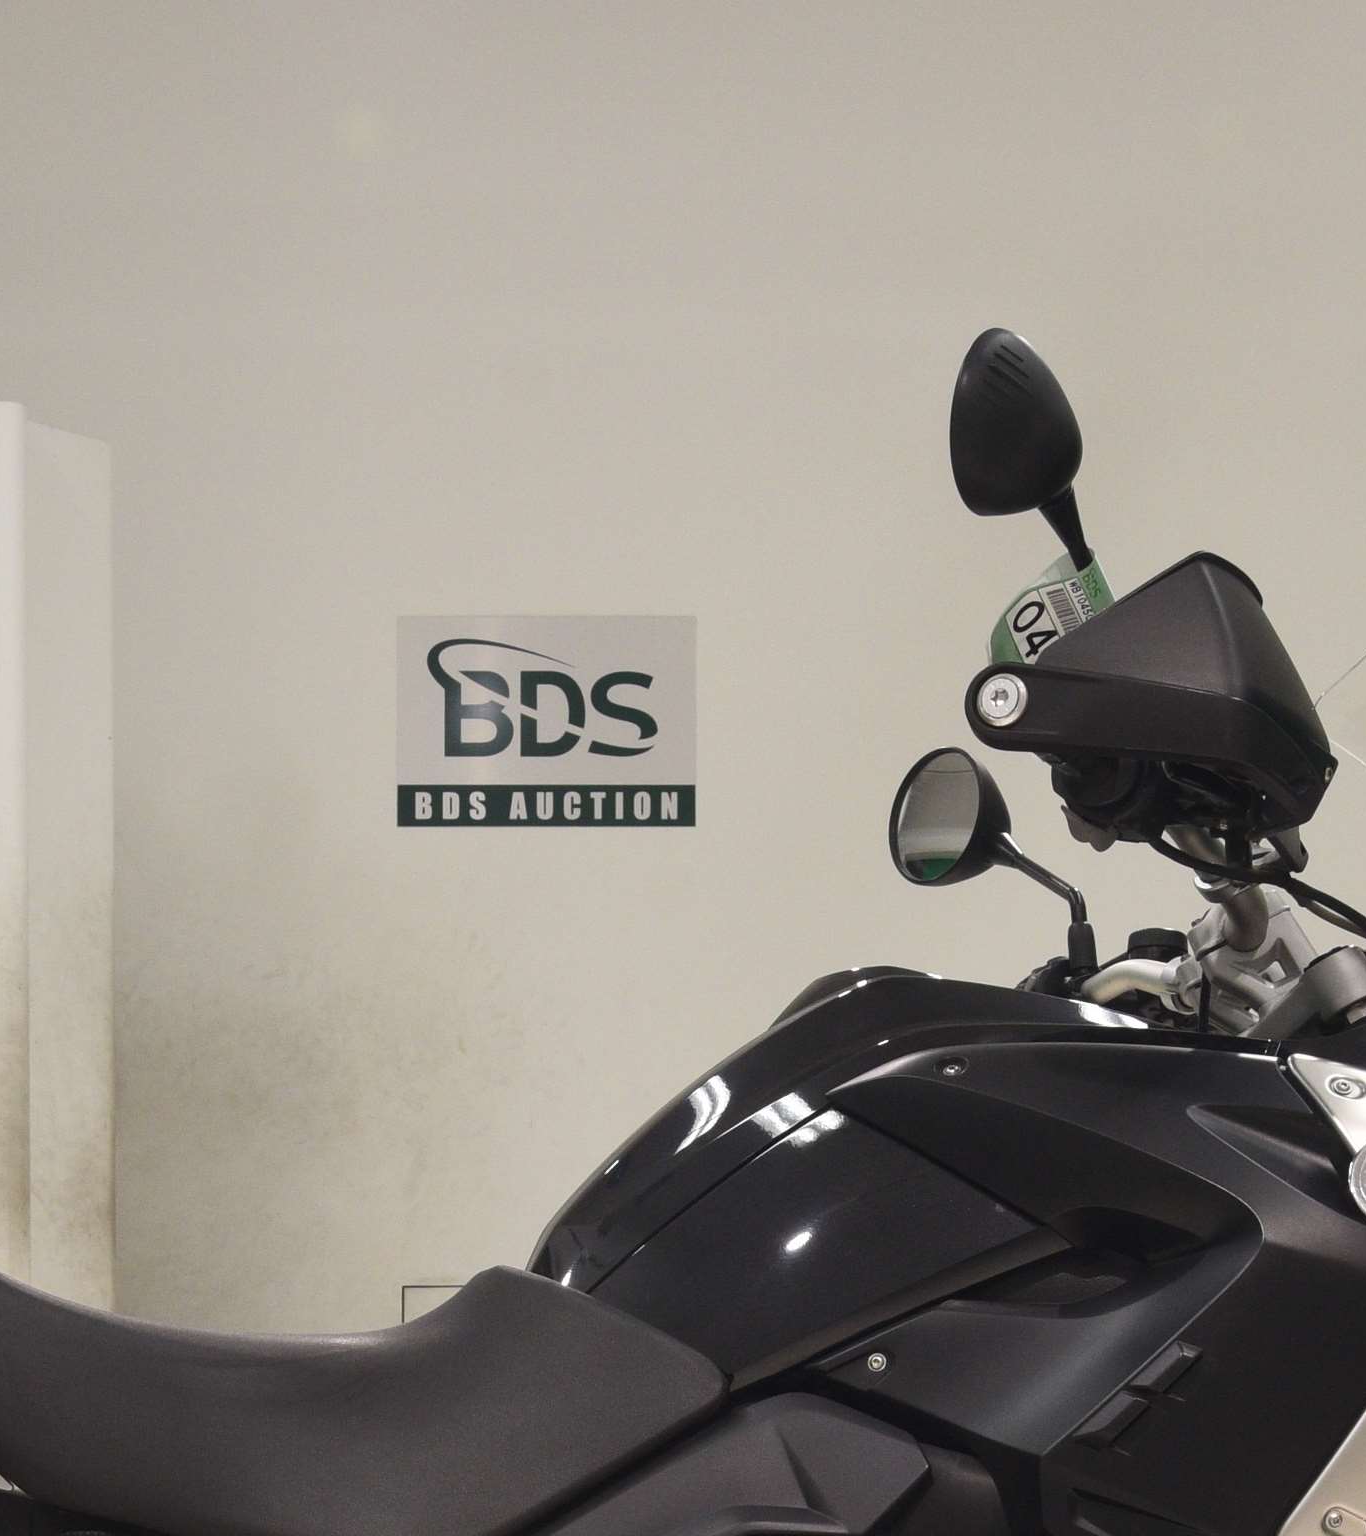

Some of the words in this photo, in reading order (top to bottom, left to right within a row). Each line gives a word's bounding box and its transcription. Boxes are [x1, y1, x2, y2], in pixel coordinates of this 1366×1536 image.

[1013, 601, 1057, 657] 04
[427, 639, 658, 757] BDS
[414, 791, 487, 821] BDS
[509, 791, 679, 821] AUCTION
